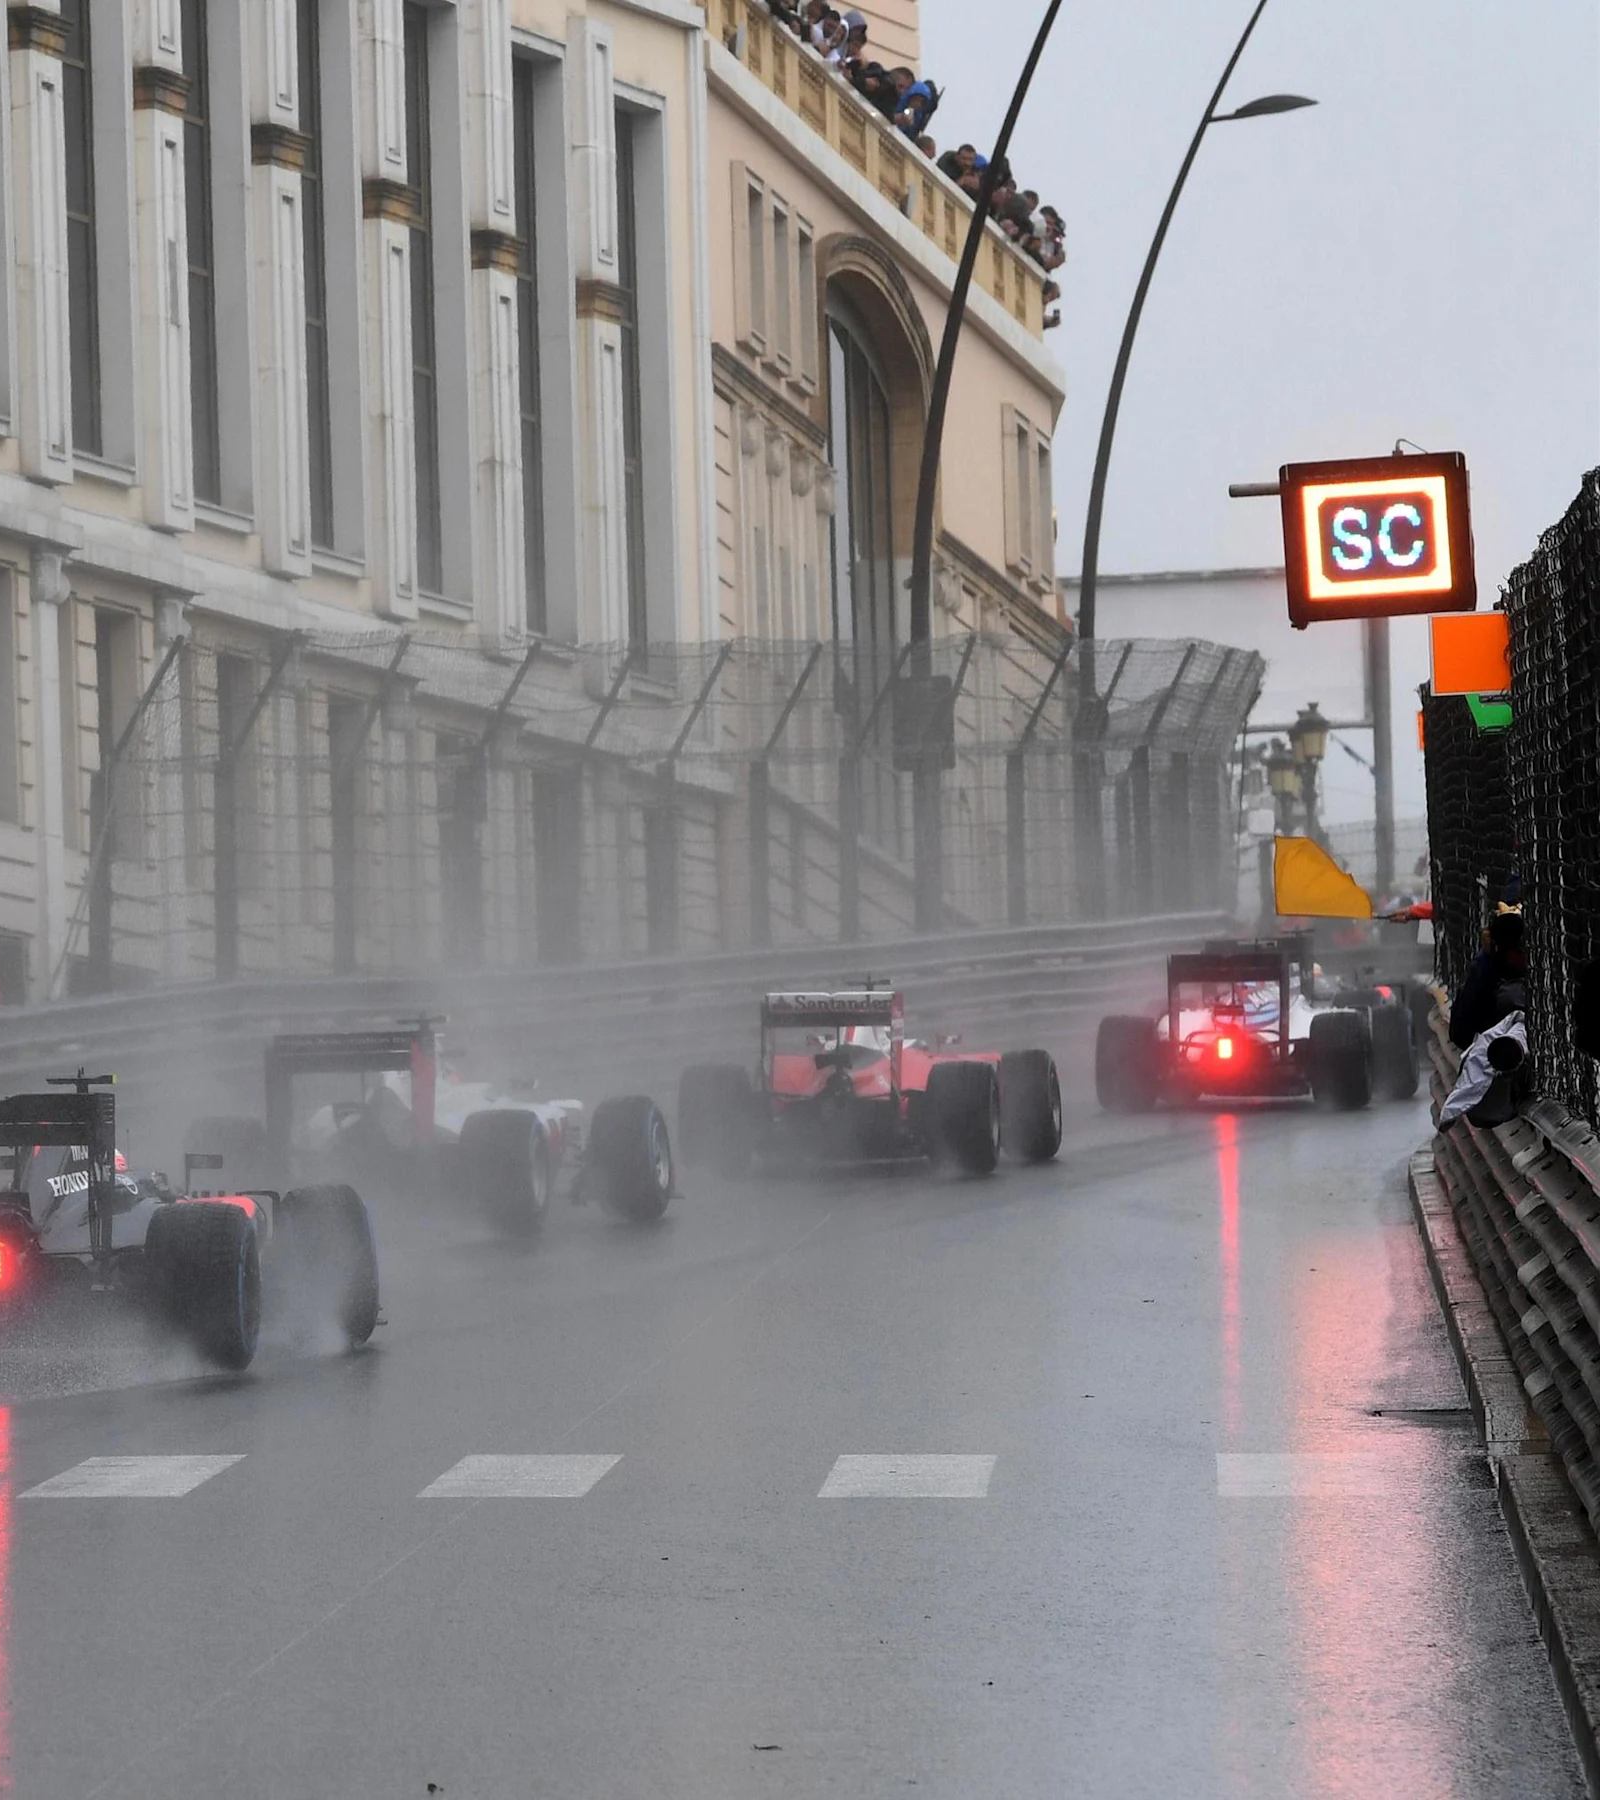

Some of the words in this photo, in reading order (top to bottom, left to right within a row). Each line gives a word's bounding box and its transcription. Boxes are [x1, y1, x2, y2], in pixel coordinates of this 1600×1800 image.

[1332, 503, 1425, 570] SC
[795, 995, 892, 1012] Santander
[47, 1170, 90, 1197] HOND
